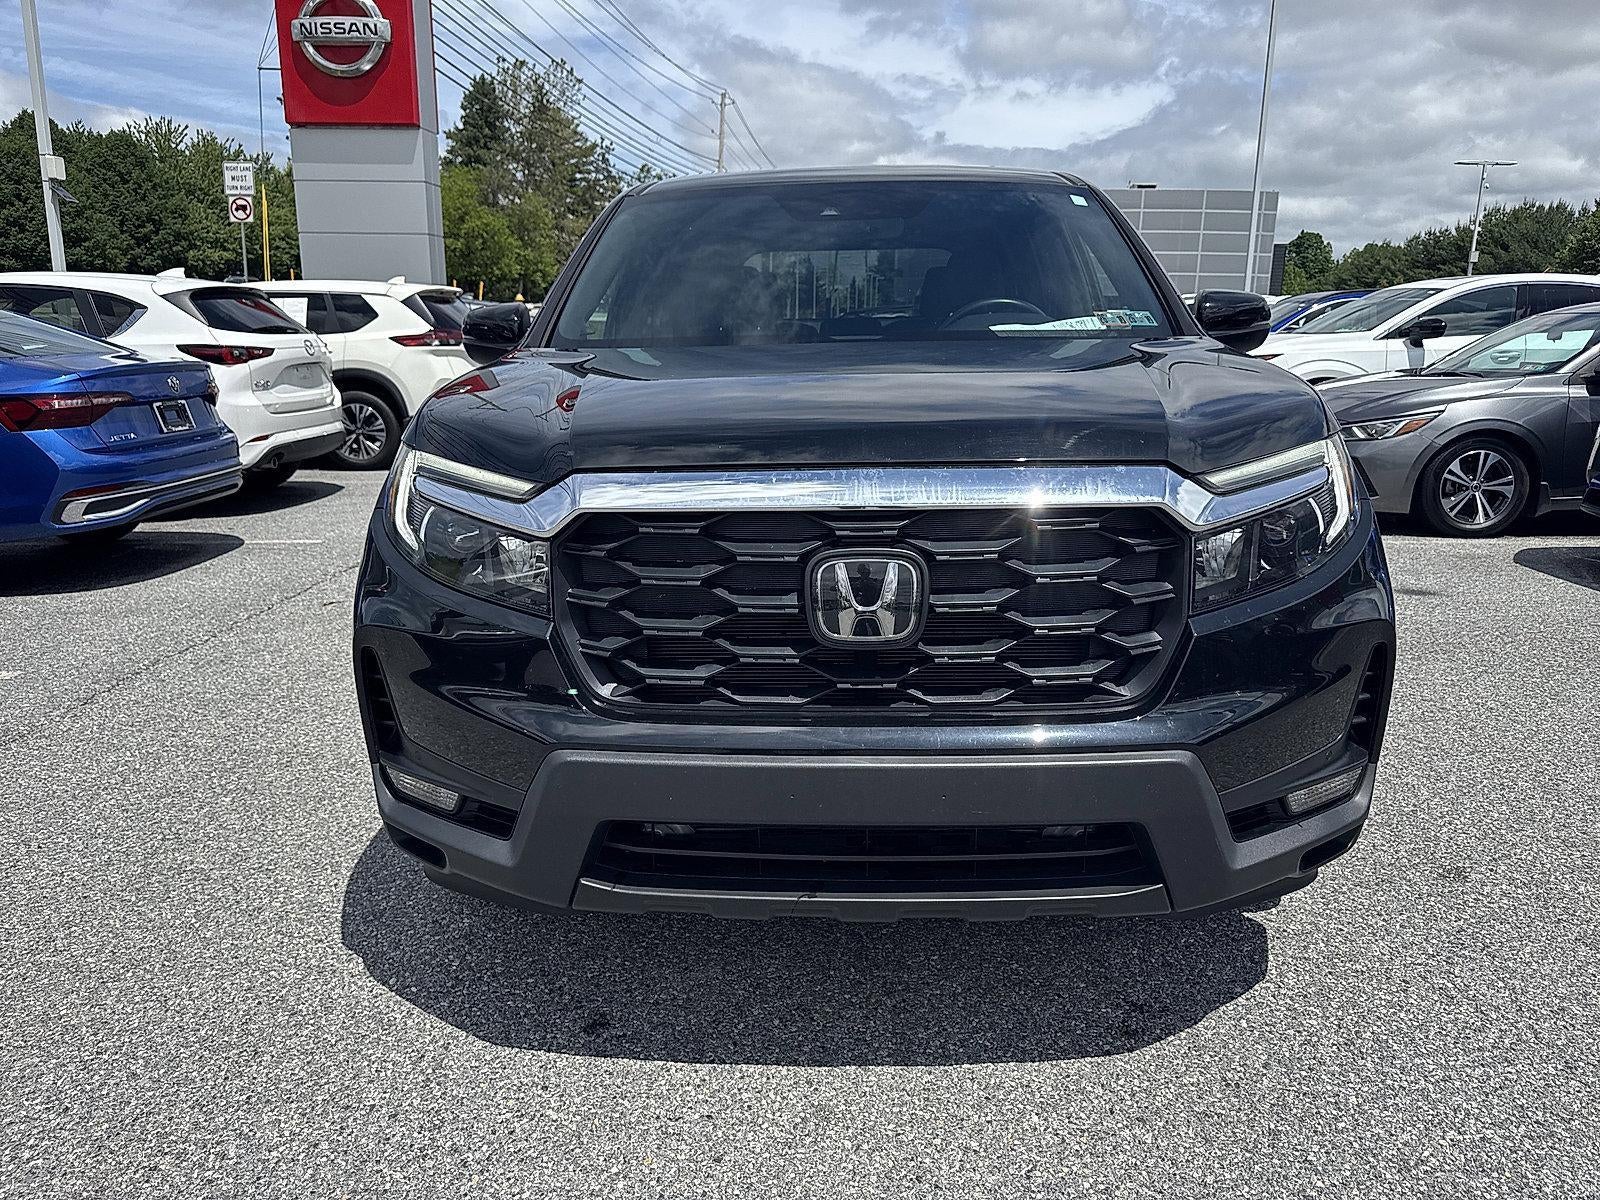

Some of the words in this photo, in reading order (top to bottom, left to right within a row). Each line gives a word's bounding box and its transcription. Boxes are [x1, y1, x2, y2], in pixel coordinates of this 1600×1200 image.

[299, 21, 379, 37] NISSAN
[230, 174, 248, 182] MUST
[109, 432, 138, 442] JETTA
